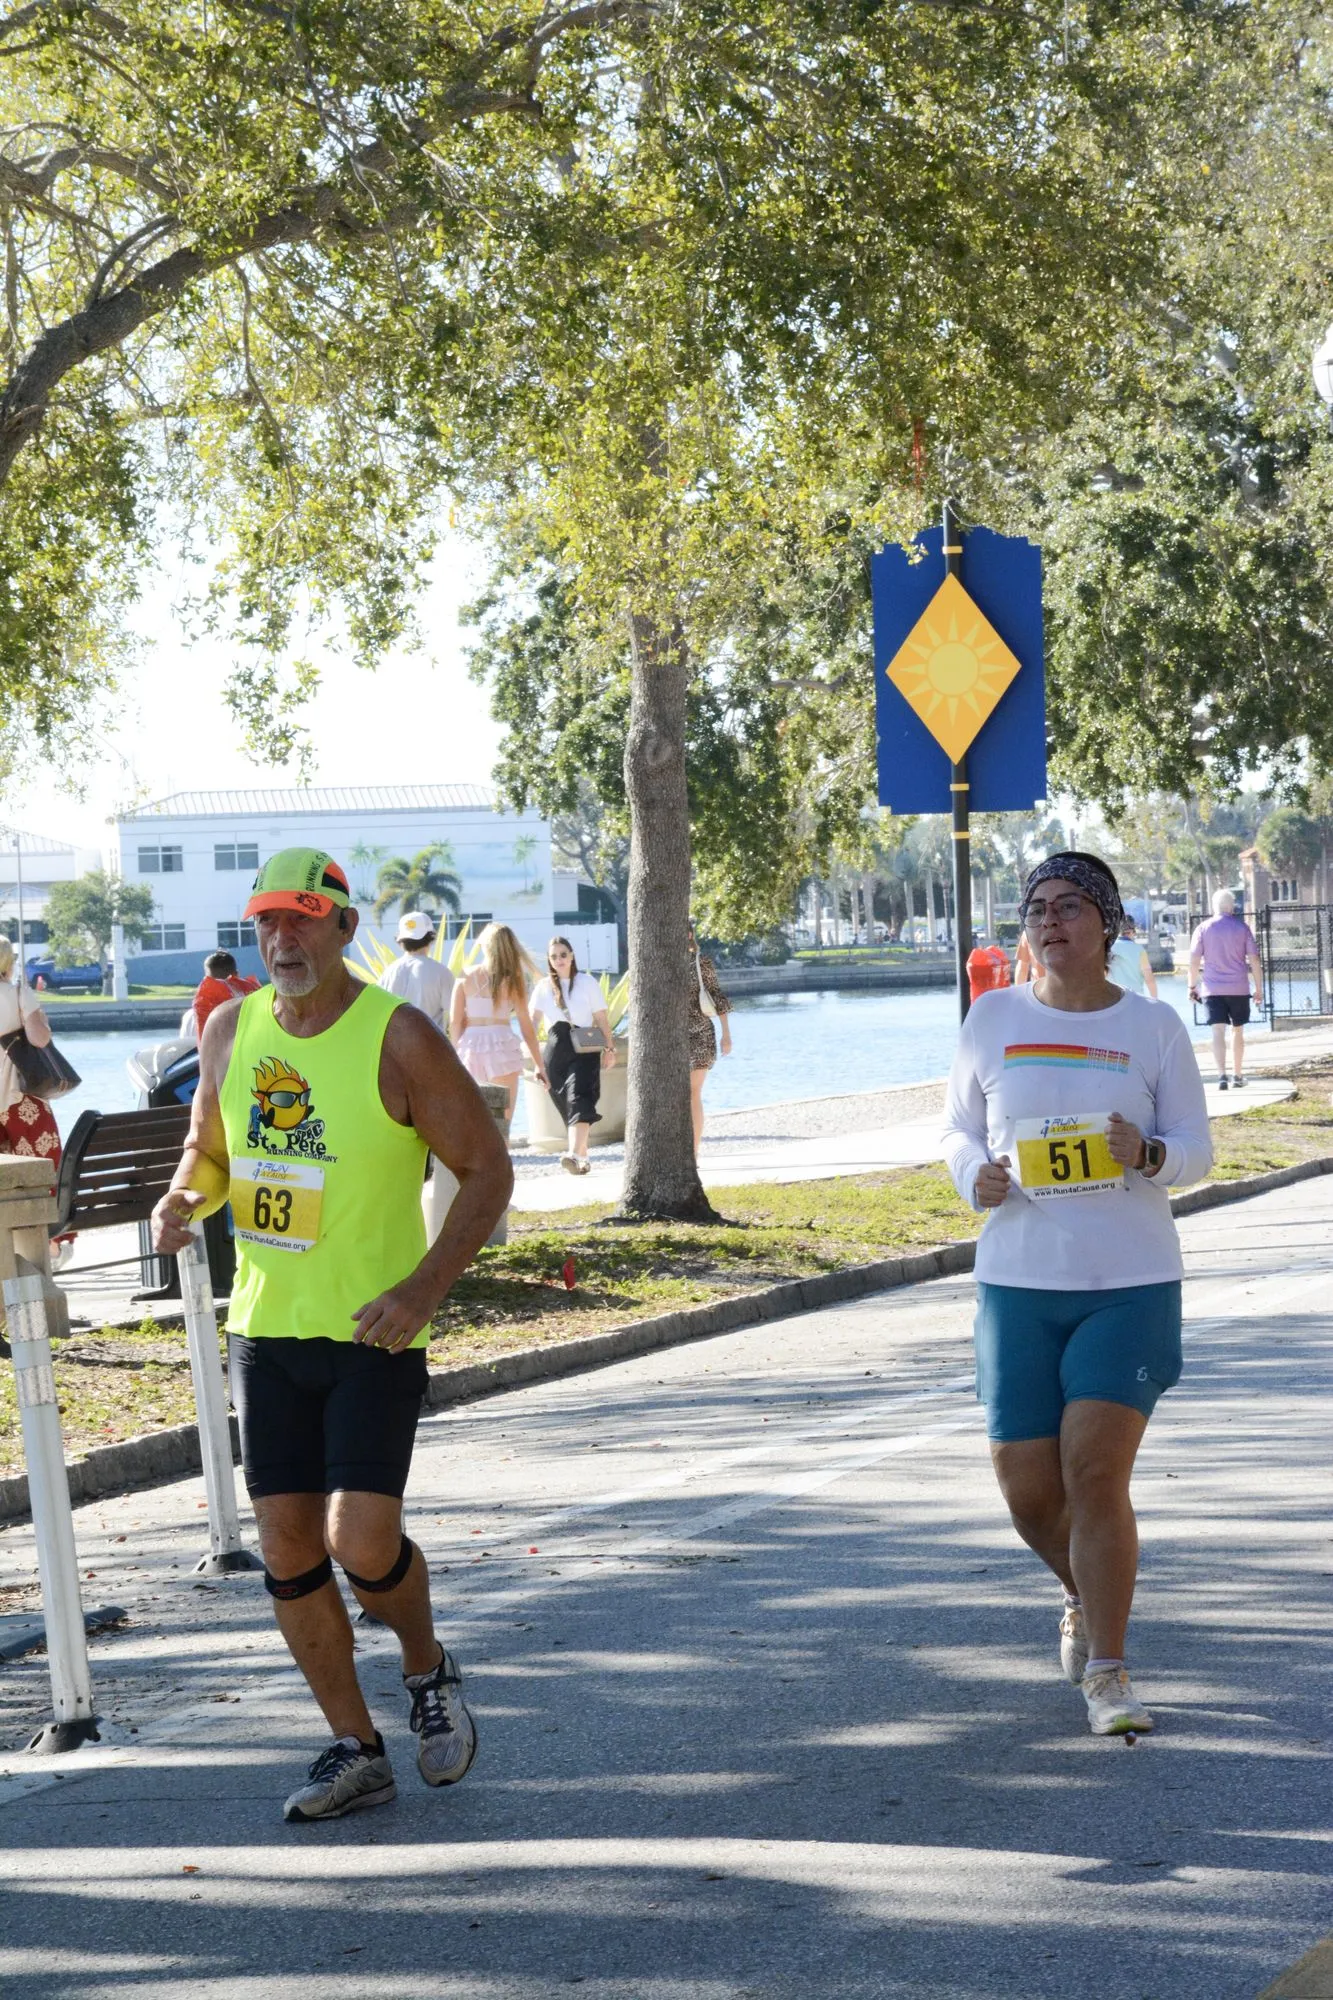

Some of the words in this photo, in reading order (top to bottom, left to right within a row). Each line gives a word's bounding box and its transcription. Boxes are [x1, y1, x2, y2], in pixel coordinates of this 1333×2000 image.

[247, 1131, 277, 1150] St.
[285, 1132, 327, 1155] Pete
[266, 1148, 303, 1157] RUNNING
[304, 1151, 338, 1164] COMPANY
[1048, 1139, 1091, 1181] 51
[1033, 1182, 1116, 1197] www.Run4aCause.org
[253, 1186, 293, 1233] 63
[240, 1233, 306, 1252] www.Run4aCause.org
